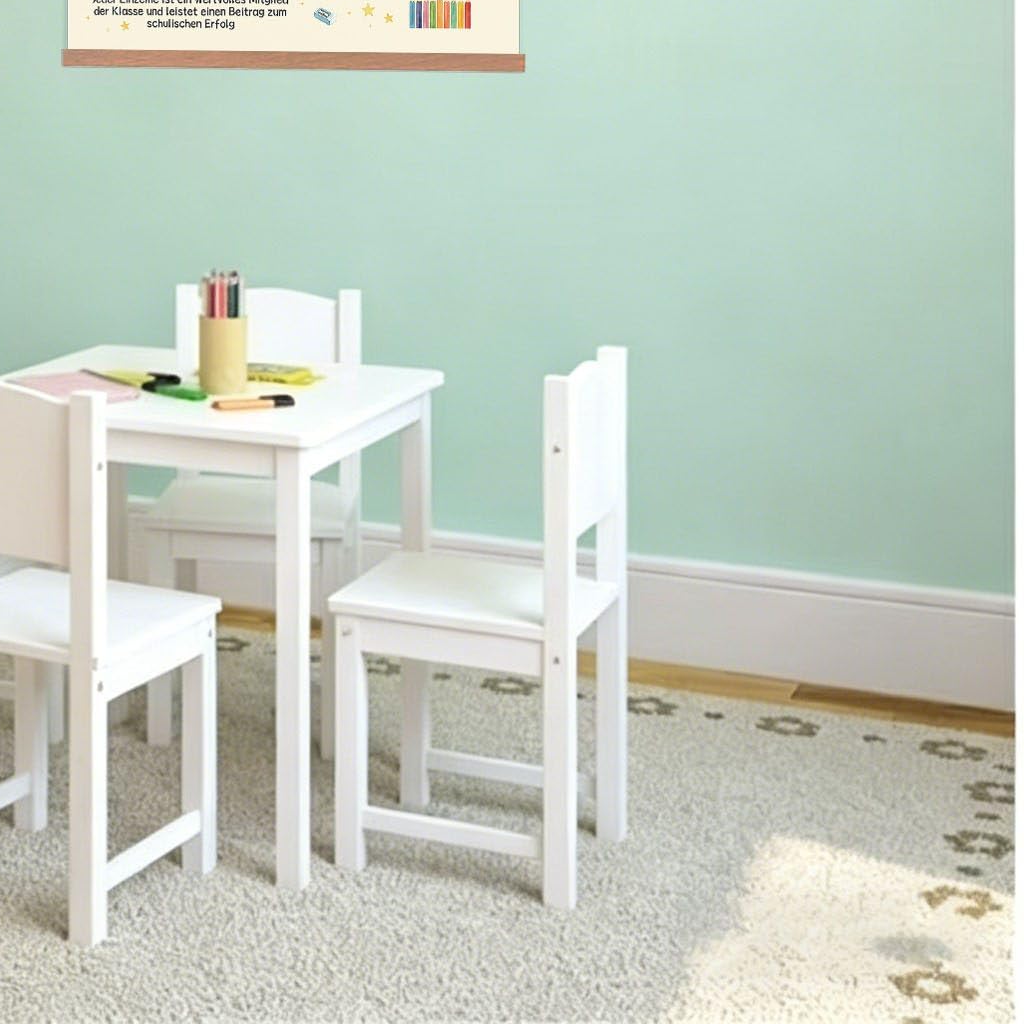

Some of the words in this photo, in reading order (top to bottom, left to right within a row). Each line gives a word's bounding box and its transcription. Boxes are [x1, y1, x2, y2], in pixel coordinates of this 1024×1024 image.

[93, 6, 109, 16] der
[112, 6, 144, 16] Klasse
[146, 6, 163, 16] und
[166, 7, 198, 17] leistet
[201, 7, 226, 17] einen
[228, 6, 265, 18] Beitrag
[267, 9, 287, 17] zum
[147, 19, 202, 29] schulischen
[204, 18, 235, 30] Erfolg
